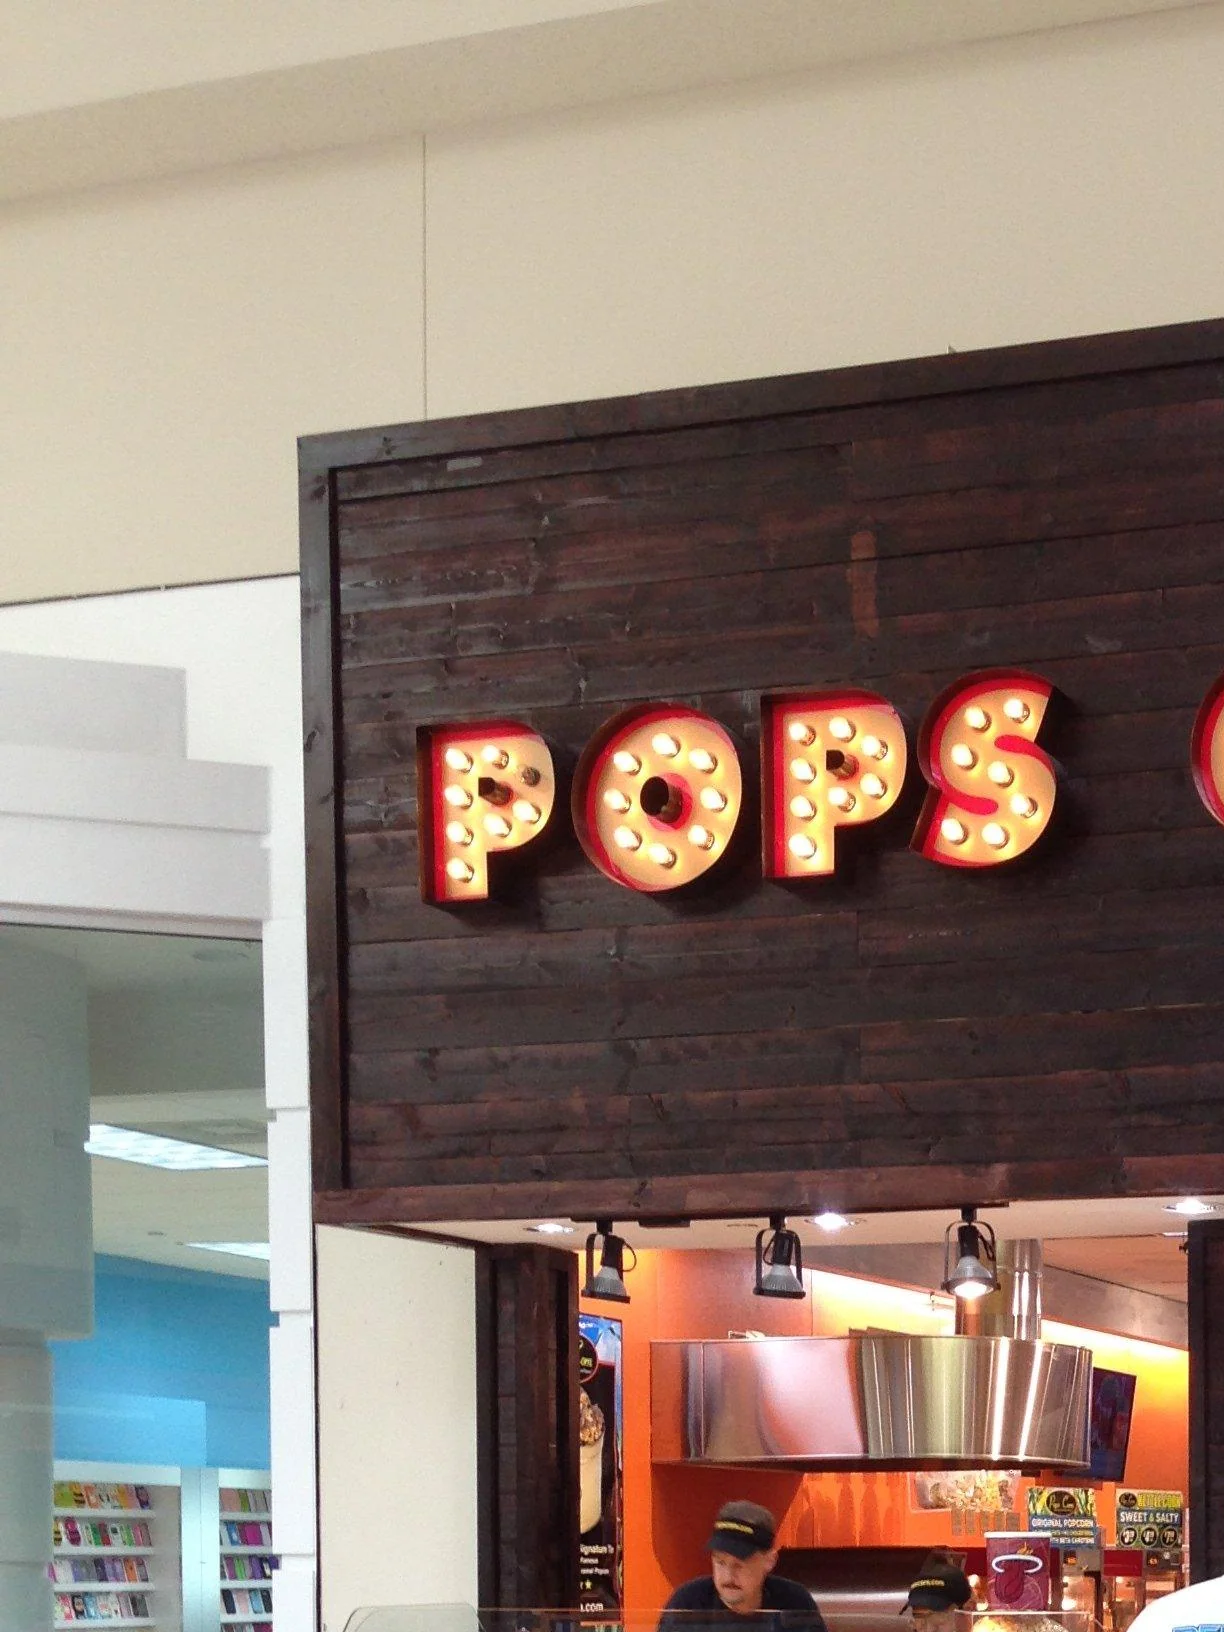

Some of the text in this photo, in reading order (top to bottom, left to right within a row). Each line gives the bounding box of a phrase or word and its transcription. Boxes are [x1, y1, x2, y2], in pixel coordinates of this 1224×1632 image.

[417, 667, 1057, 902] POPS
[1120, 1510, 1148, 1523] SWEET
[1155, 1512, 1179, 1523] SALTY
